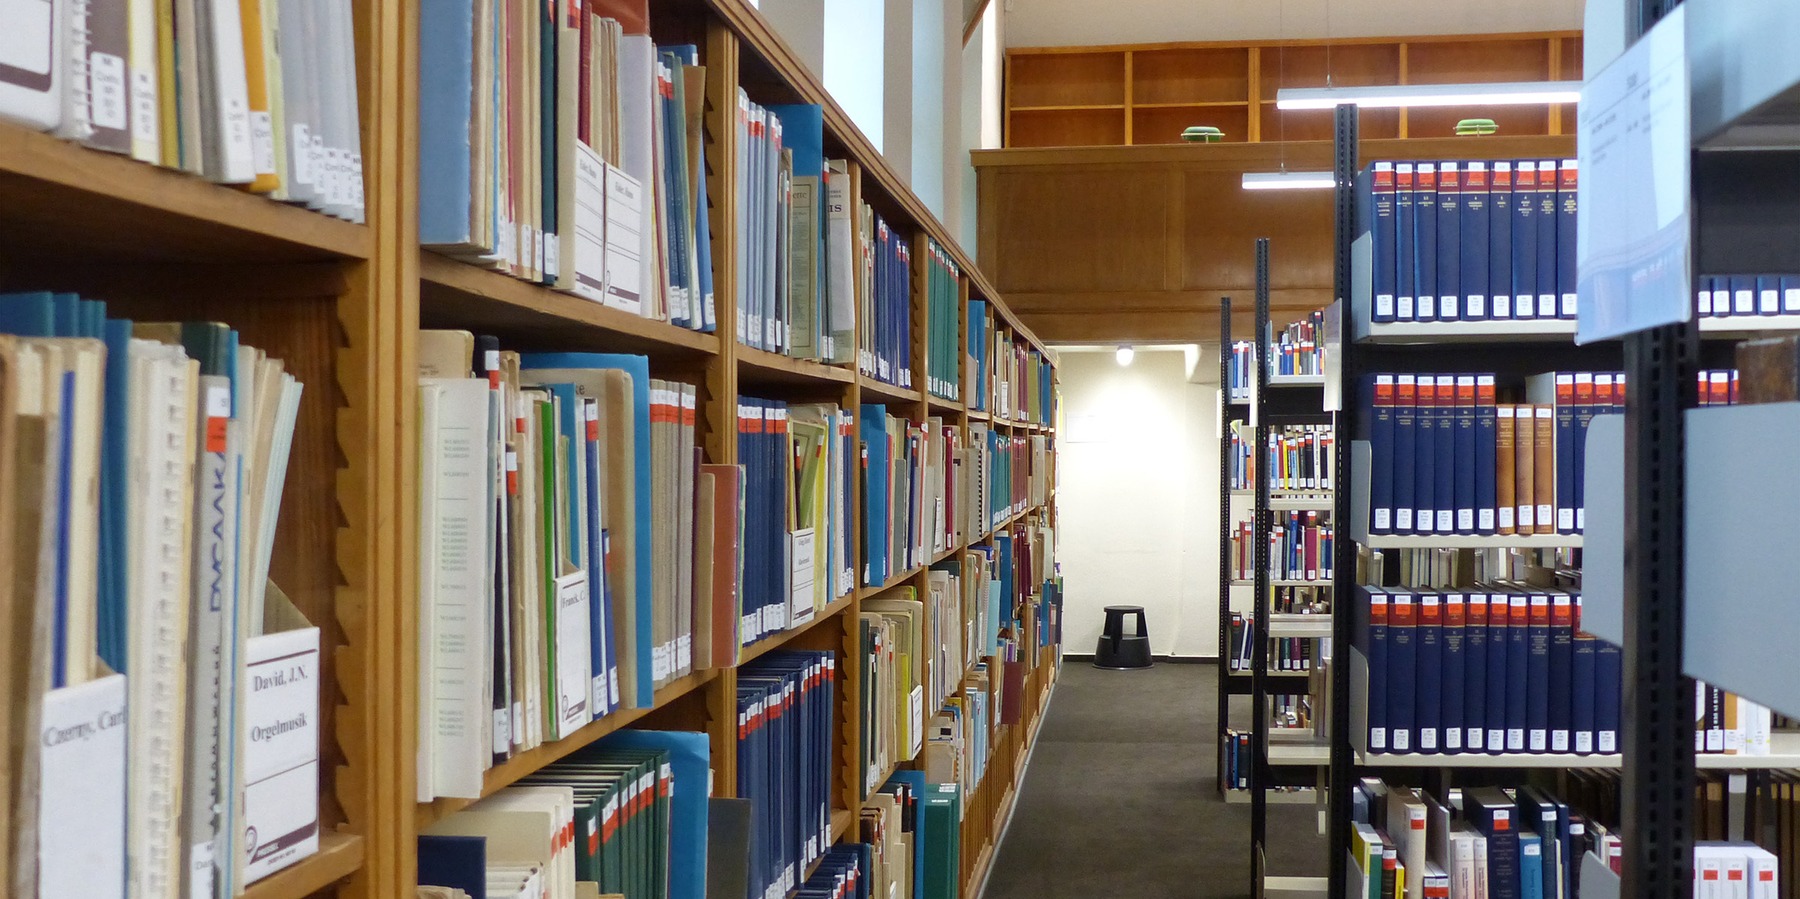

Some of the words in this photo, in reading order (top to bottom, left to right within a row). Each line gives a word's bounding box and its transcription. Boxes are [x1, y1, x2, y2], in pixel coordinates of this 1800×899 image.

[254, 670, 286, 692] David,
[288, 664, 308, 682] J.N.
[43, 722, 97, 747] Czerny,
[251, 712, 308, 743] Orgelmusik
